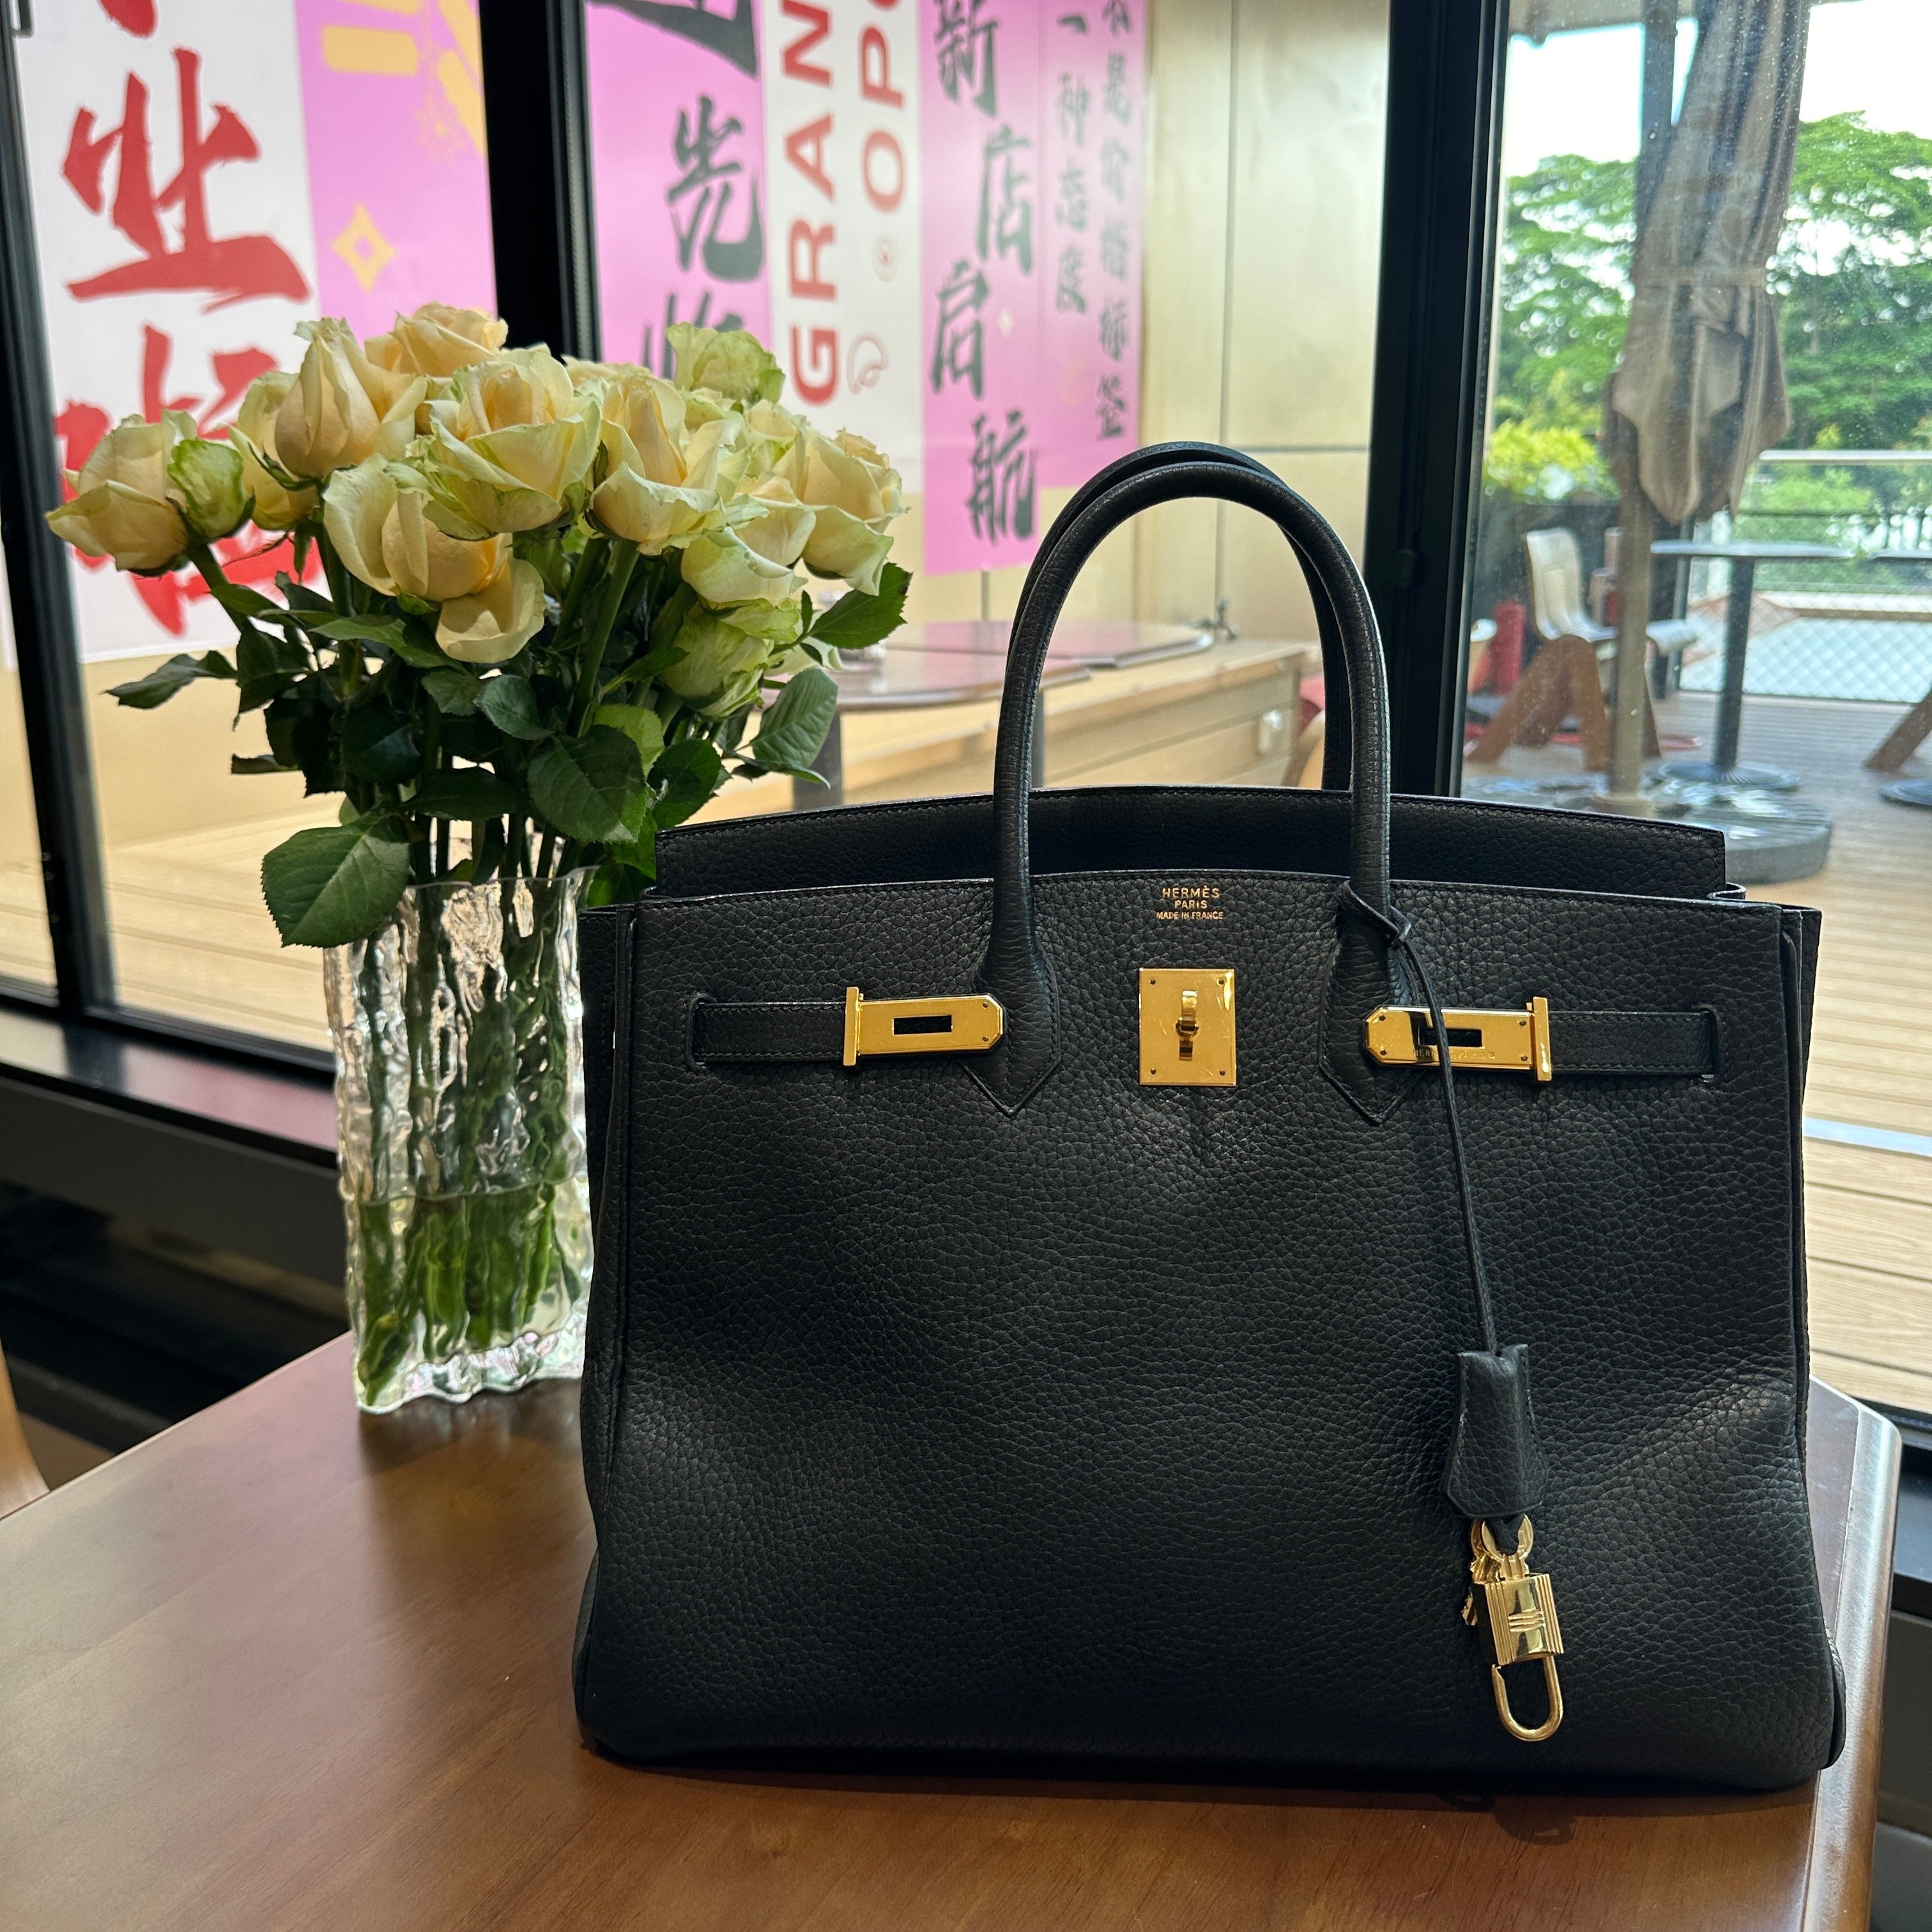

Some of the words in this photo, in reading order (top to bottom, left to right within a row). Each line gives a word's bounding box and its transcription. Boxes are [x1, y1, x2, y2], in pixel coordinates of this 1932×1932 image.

[859, 0, 907, 215] OP
[931, 0, 1036, 547] 新店启航
[1162, 885, 1220, 898] HERMÈS
[1174, 900, 1208, 909] PARIS
[1156, 911, 1179, 920] MADE
[1181, 911, 1190, 920] IN
[1192, 911, 1224, 920] FRANCE
